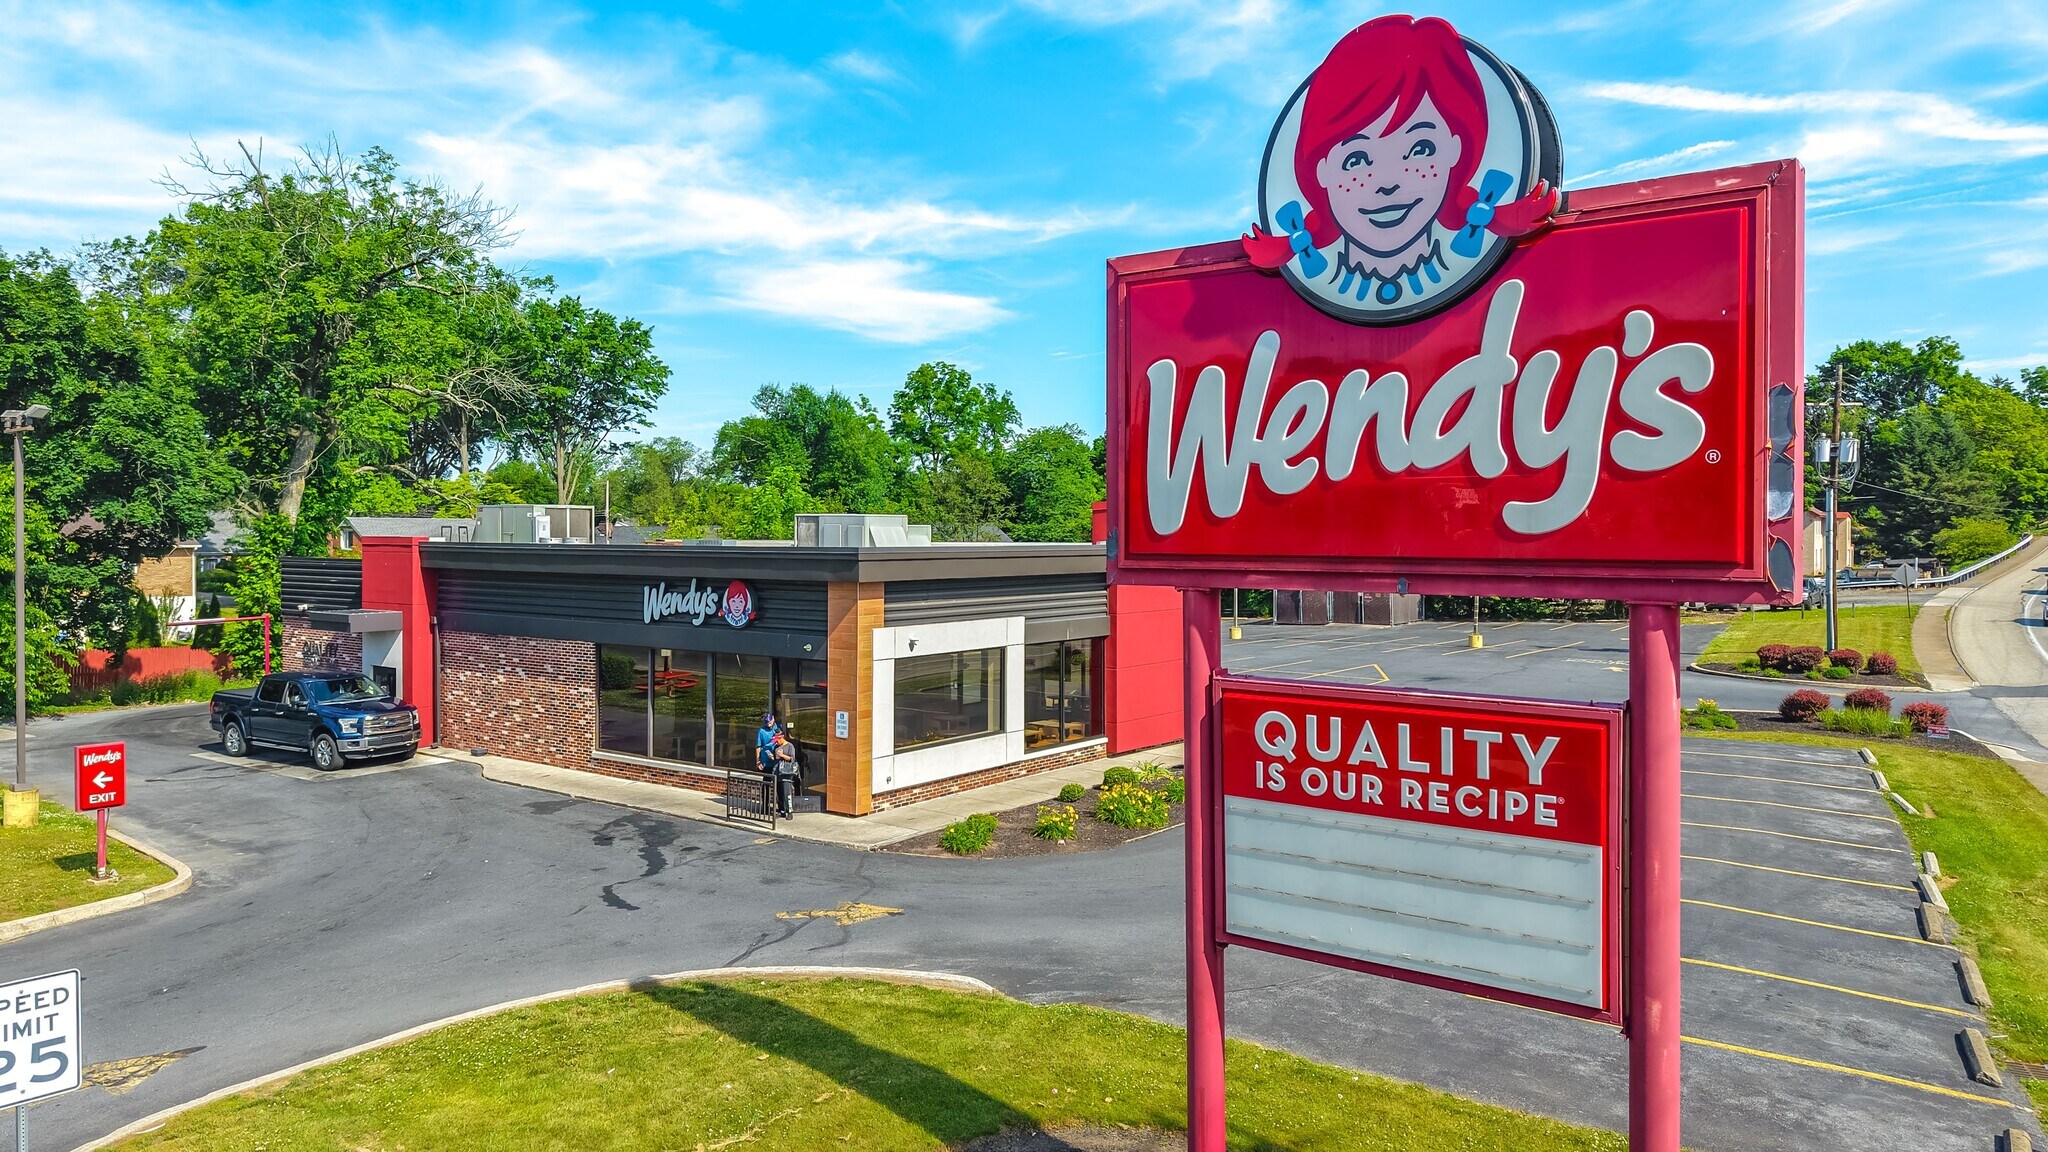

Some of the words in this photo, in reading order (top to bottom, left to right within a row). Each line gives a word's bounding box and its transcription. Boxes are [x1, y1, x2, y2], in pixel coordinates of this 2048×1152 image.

[643, 577, 718, 626] Wendy's
[83, 749, 122, 767] Wendy's
[1254, 710, 1561, 786] QUALITY
[89, 791, 117, 804] EXIT
[1255, 760, 1286, 792] IS
[1300, 767, 1384, 806] OUR
